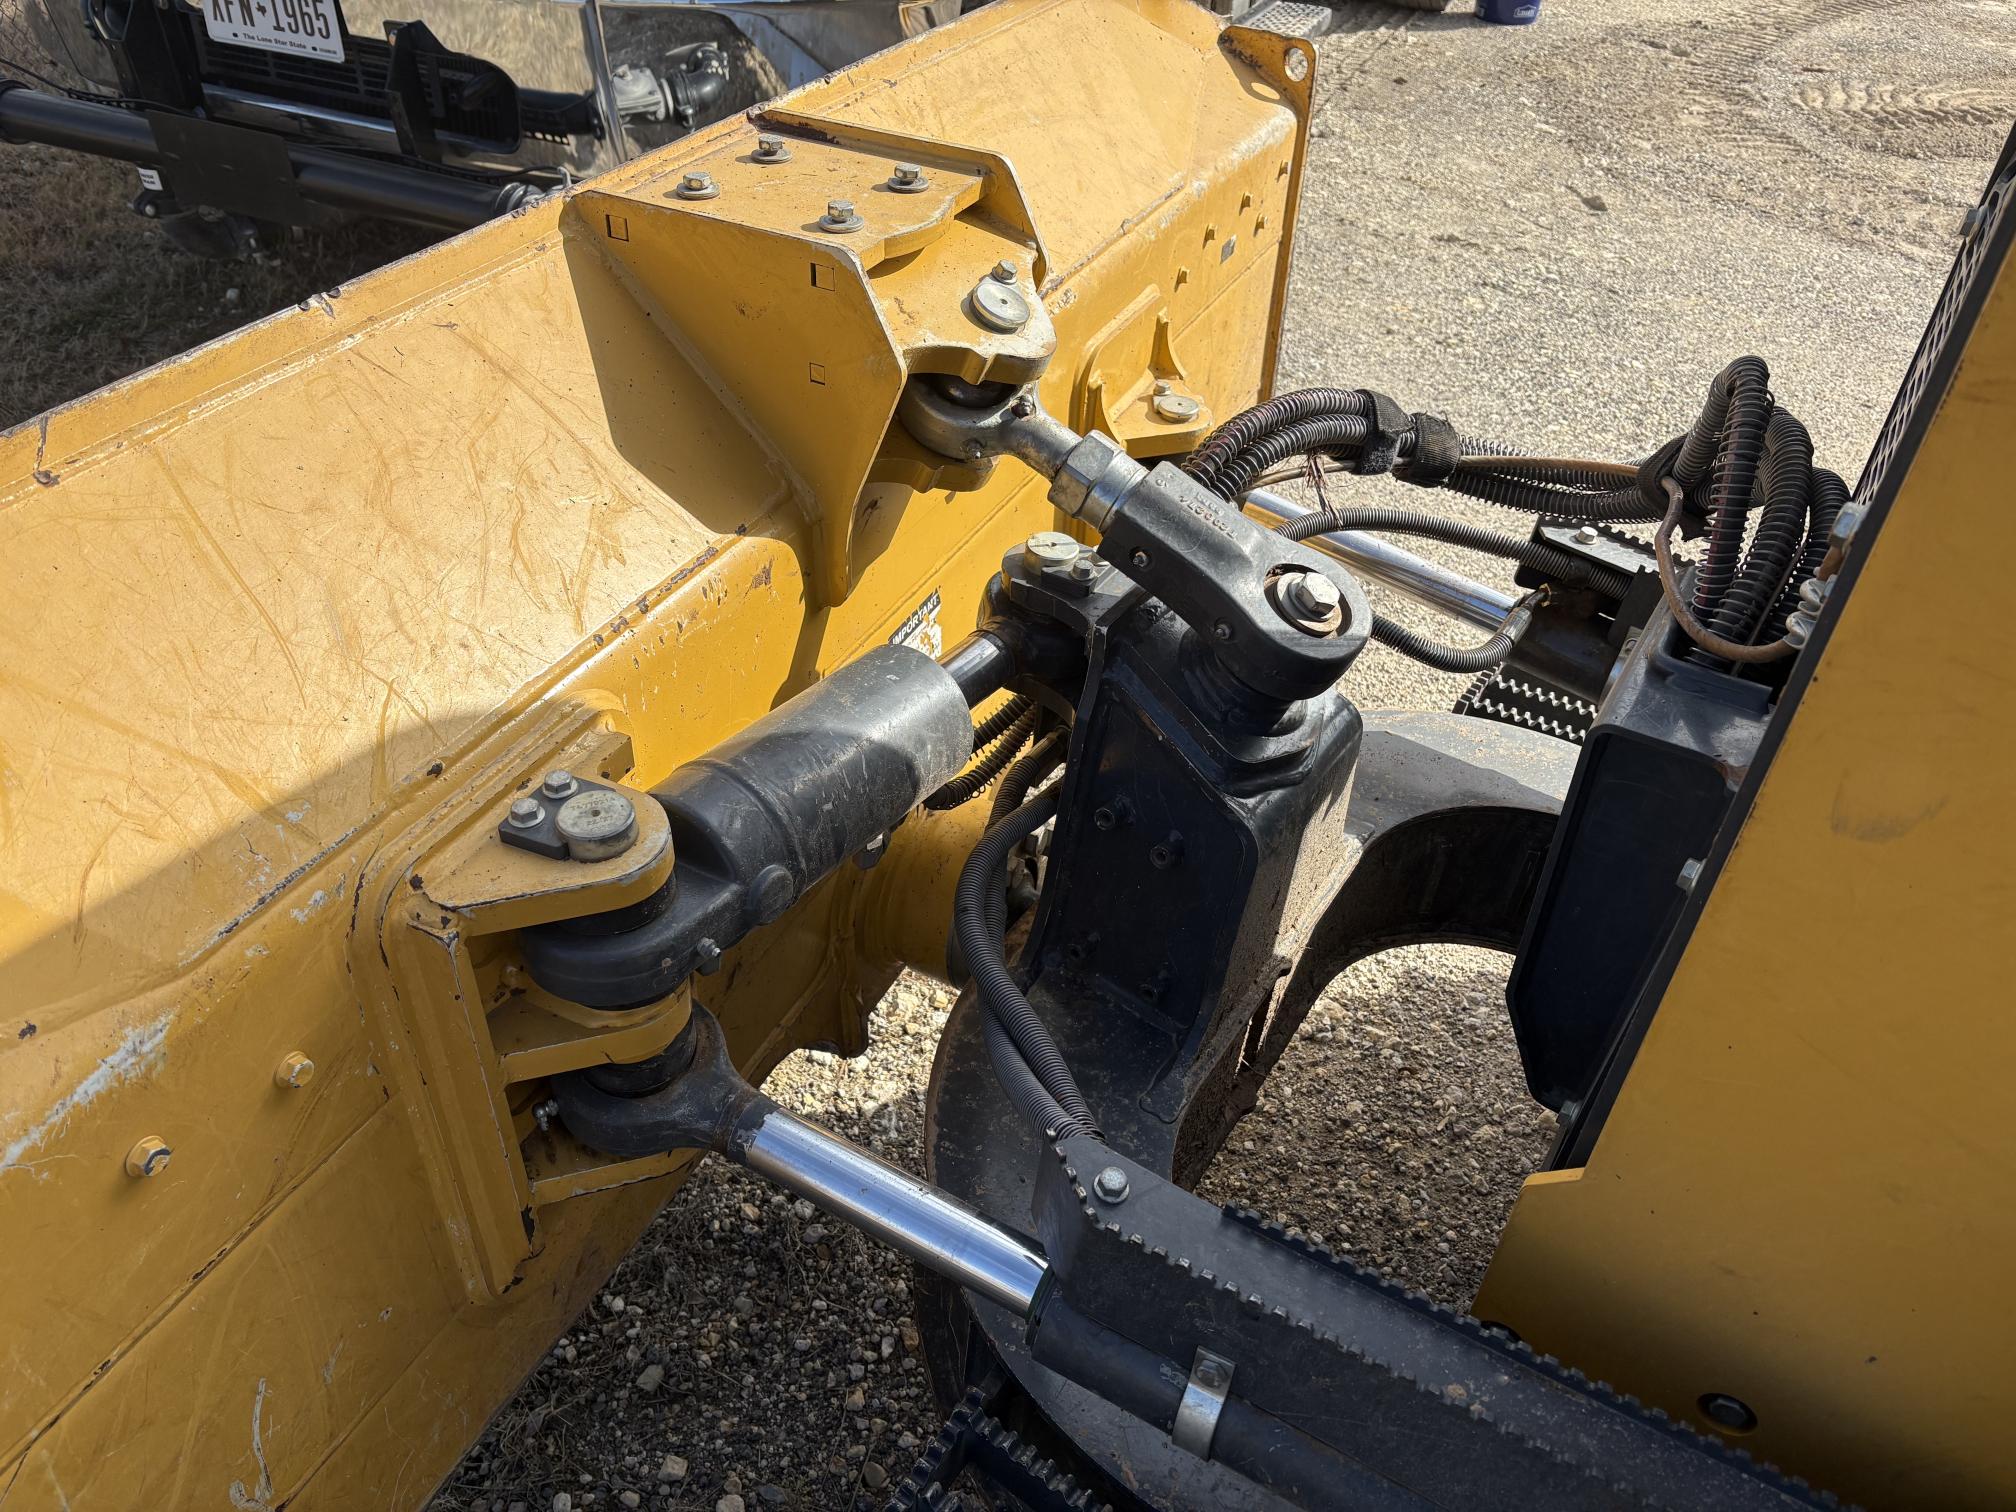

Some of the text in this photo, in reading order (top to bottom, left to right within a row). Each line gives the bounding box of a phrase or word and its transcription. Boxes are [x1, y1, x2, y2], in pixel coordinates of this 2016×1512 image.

[256, 35, 273, 43] Lone
[274, 38, 287, 46] Star
[289, 41, 307, 49] State
[892, 593, 940, 645] IMPORTANT
